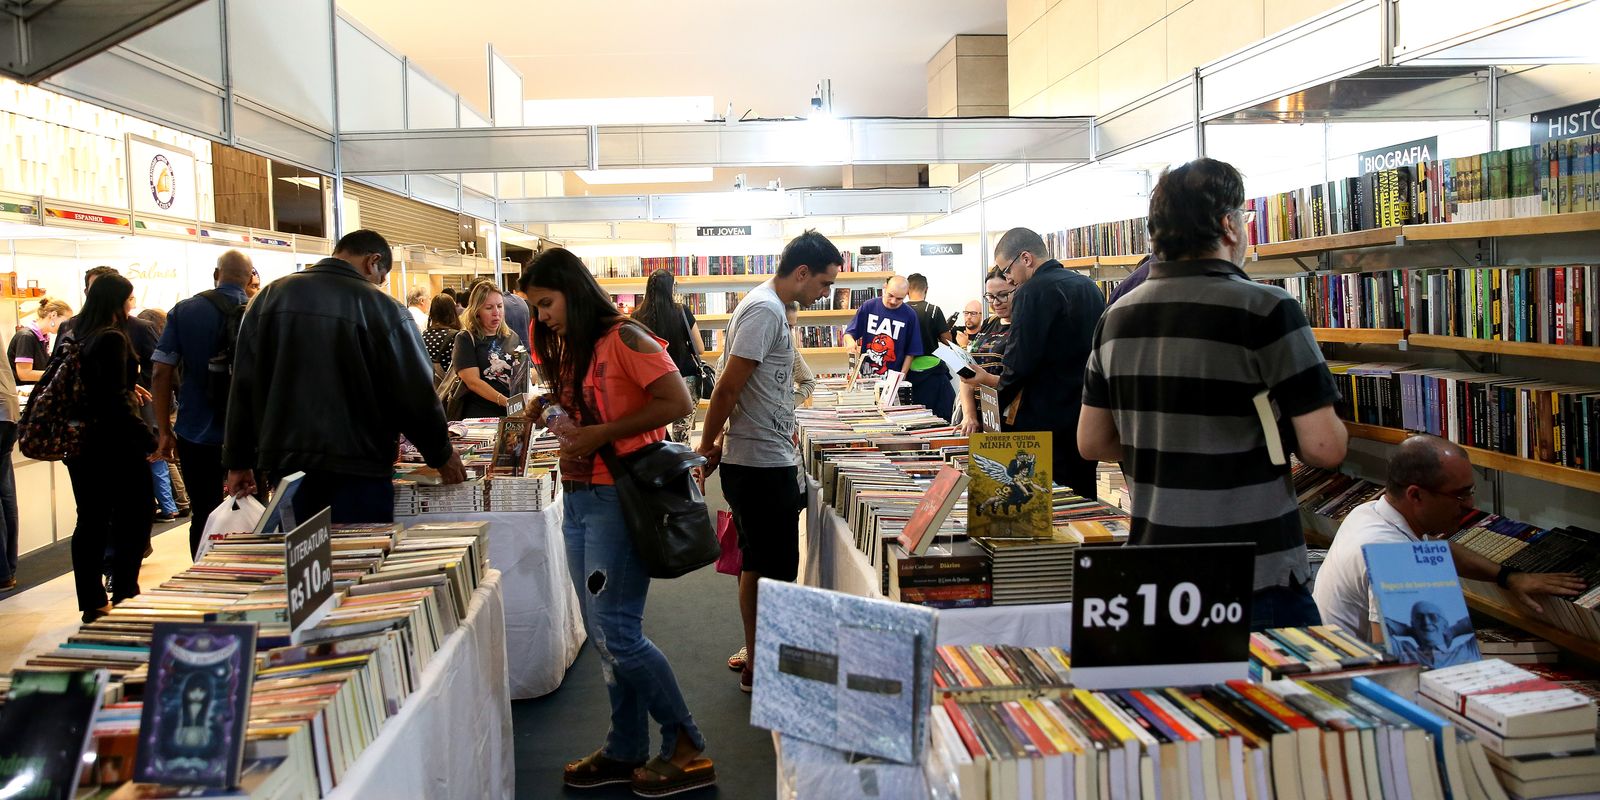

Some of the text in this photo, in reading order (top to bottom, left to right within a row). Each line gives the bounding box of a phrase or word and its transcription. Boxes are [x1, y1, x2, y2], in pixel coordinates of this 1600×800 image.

[1364, 145, 1431, 172] BIOGRAFIA
[75, 213, 104, 223] ESPANHOL
[702, 227, 746, 236] LIT. JOVEM
[929, 245, 954, 254] CAIXA
[866, 313, 905, 341] EAT
[980, 440, 1041, 449] MINHA VIDA
[290, 526, 329, 567] LITERATURA
[1412, 544, 1448, 554] Mário
[1415, 555, 1444, 566] Lago
